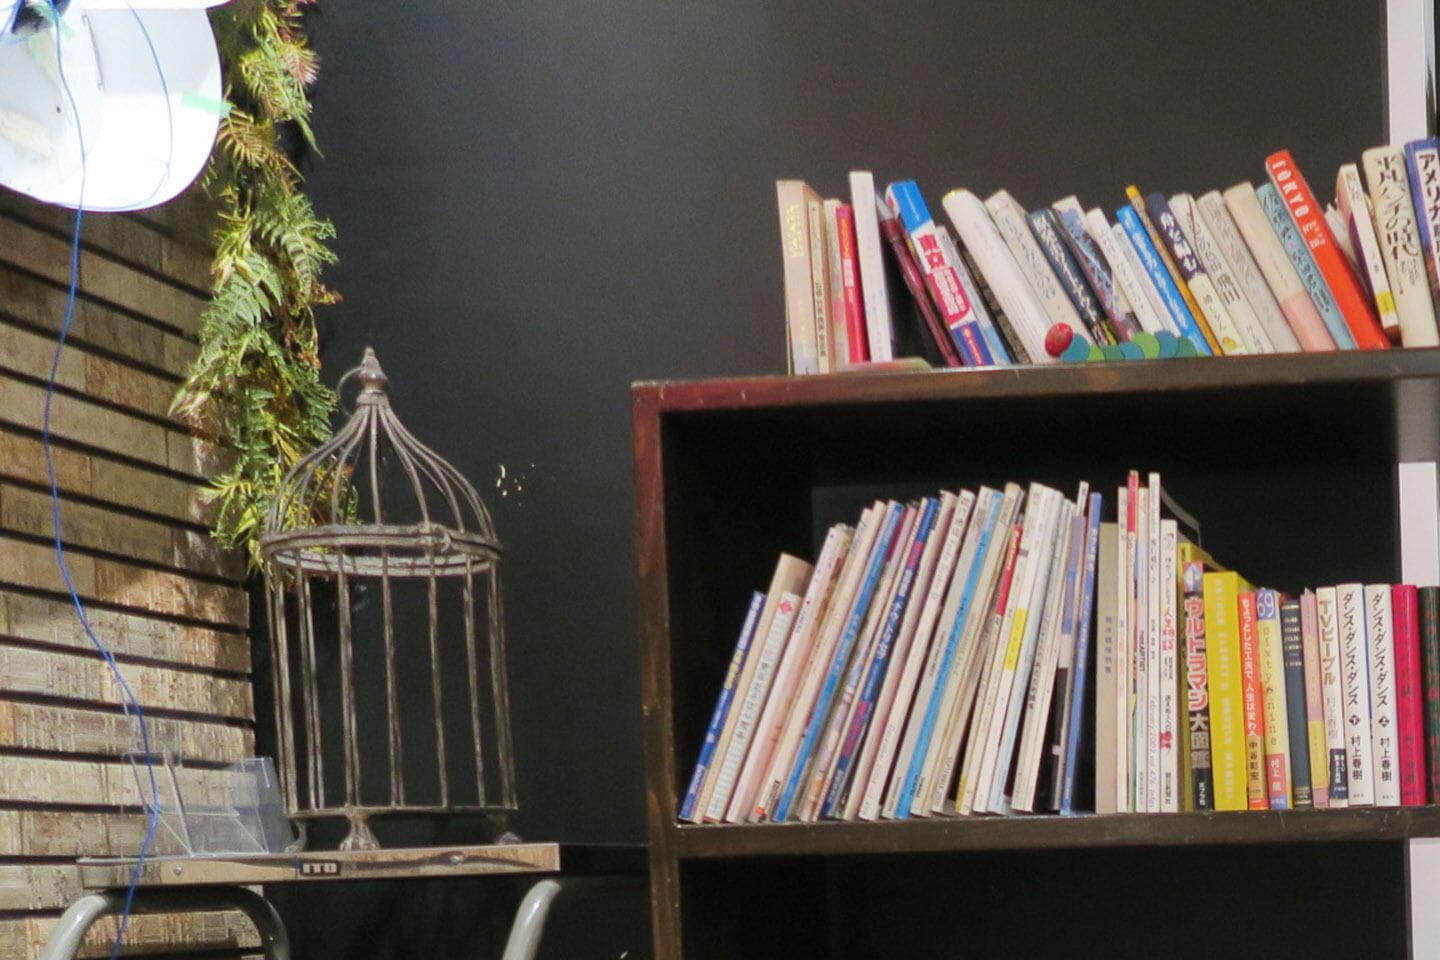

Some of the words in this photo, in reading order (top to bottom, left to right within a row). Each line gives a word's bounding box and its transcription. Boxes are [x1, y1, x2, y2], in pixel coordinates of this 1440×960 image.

[1270, 160, 1309, 218] TOKYO
[1375, 155, 1418, 261] 平凡パンチの時代
[1257, 591, 1275, 619] 69
[1319, 600, 1337, 684] TVピープル
[1184, 600, 1208, 712] ウルトラマン
[1343, 592, 1363, 707] ダンス・ダンス・ダンス
[1373, 593, 1389, 707] ダンス・ダンス・ダンス
[1349, 736, 1363, 780] 村上春樹
[1379, 737, 1393, 783] 村上春樹
